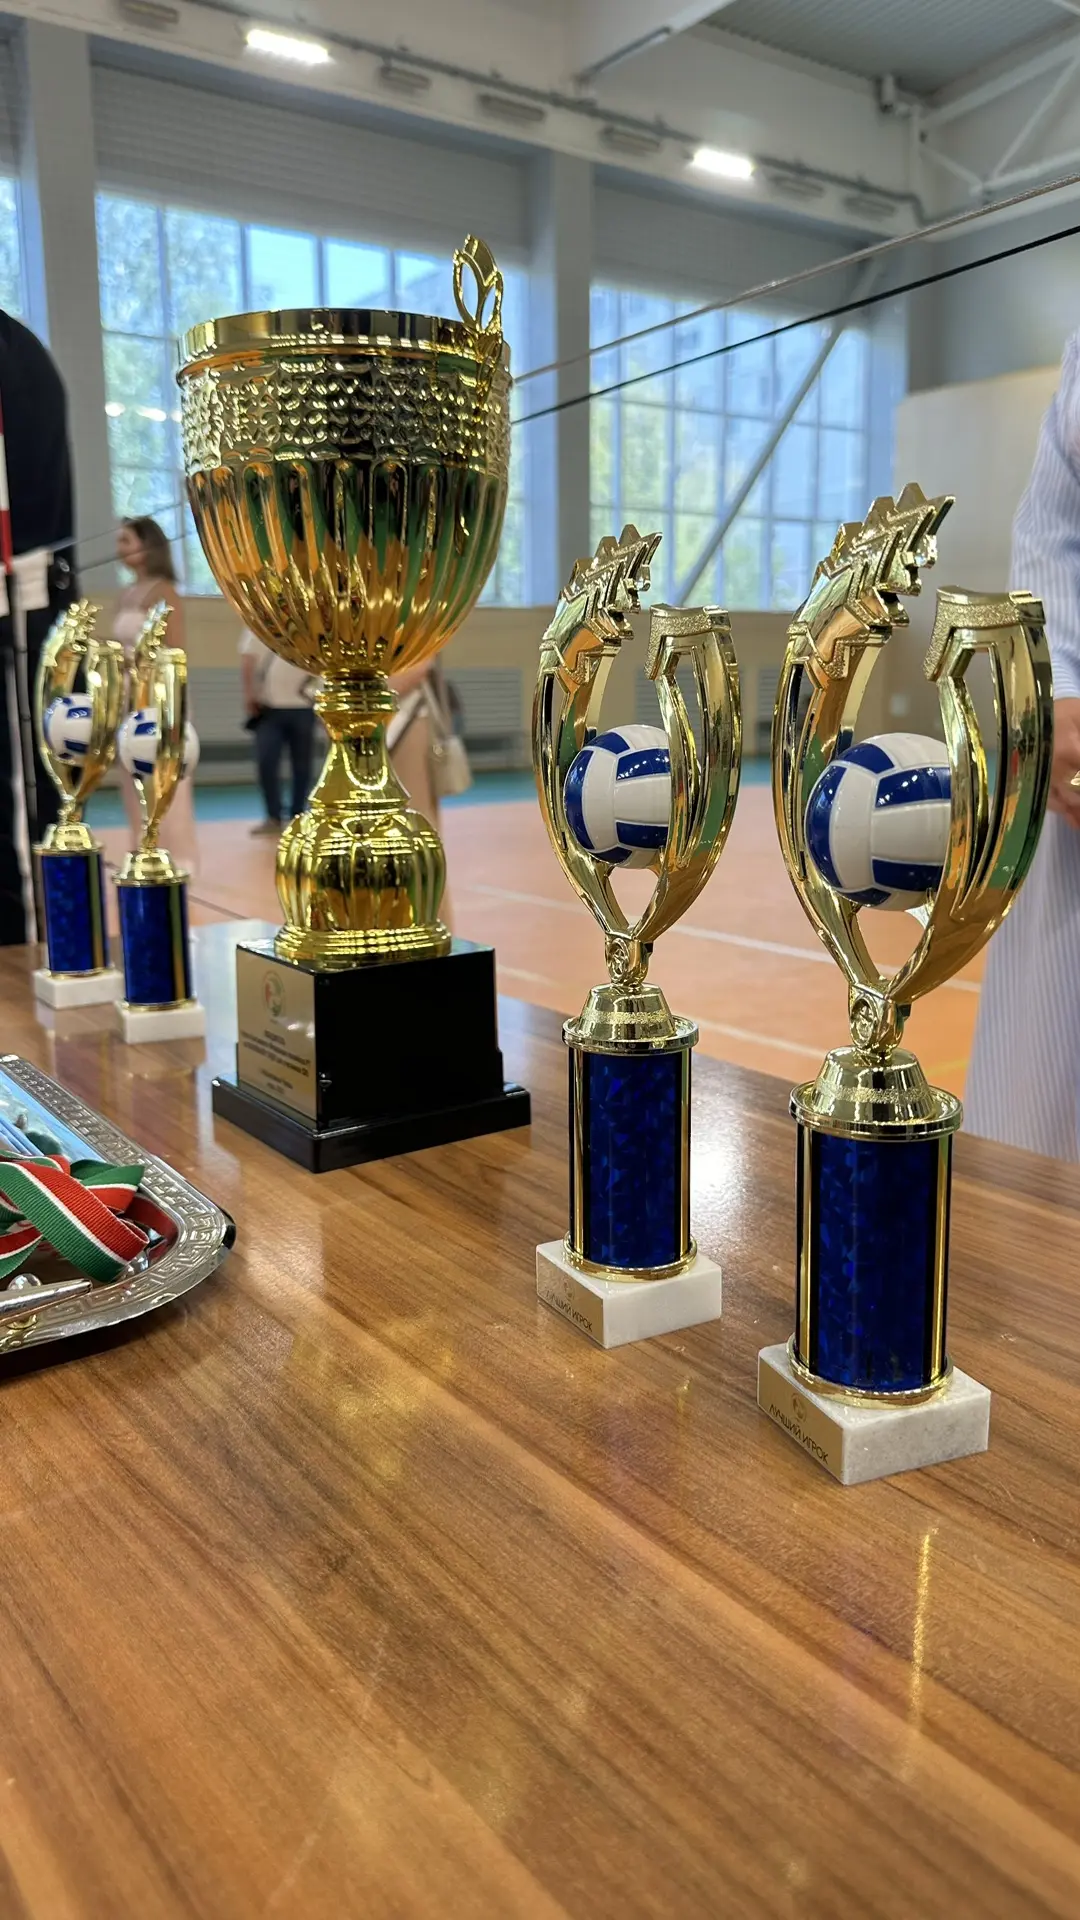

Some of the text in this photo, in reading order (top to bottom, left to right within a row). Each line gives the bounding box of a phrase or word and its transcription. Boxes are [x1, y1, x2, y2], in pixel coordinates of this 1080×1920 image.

[572, 1308, 593, 1333] ИГРОК
[769, 1403, 829, 1465] ЛУЧШИЙ ИГРОК
